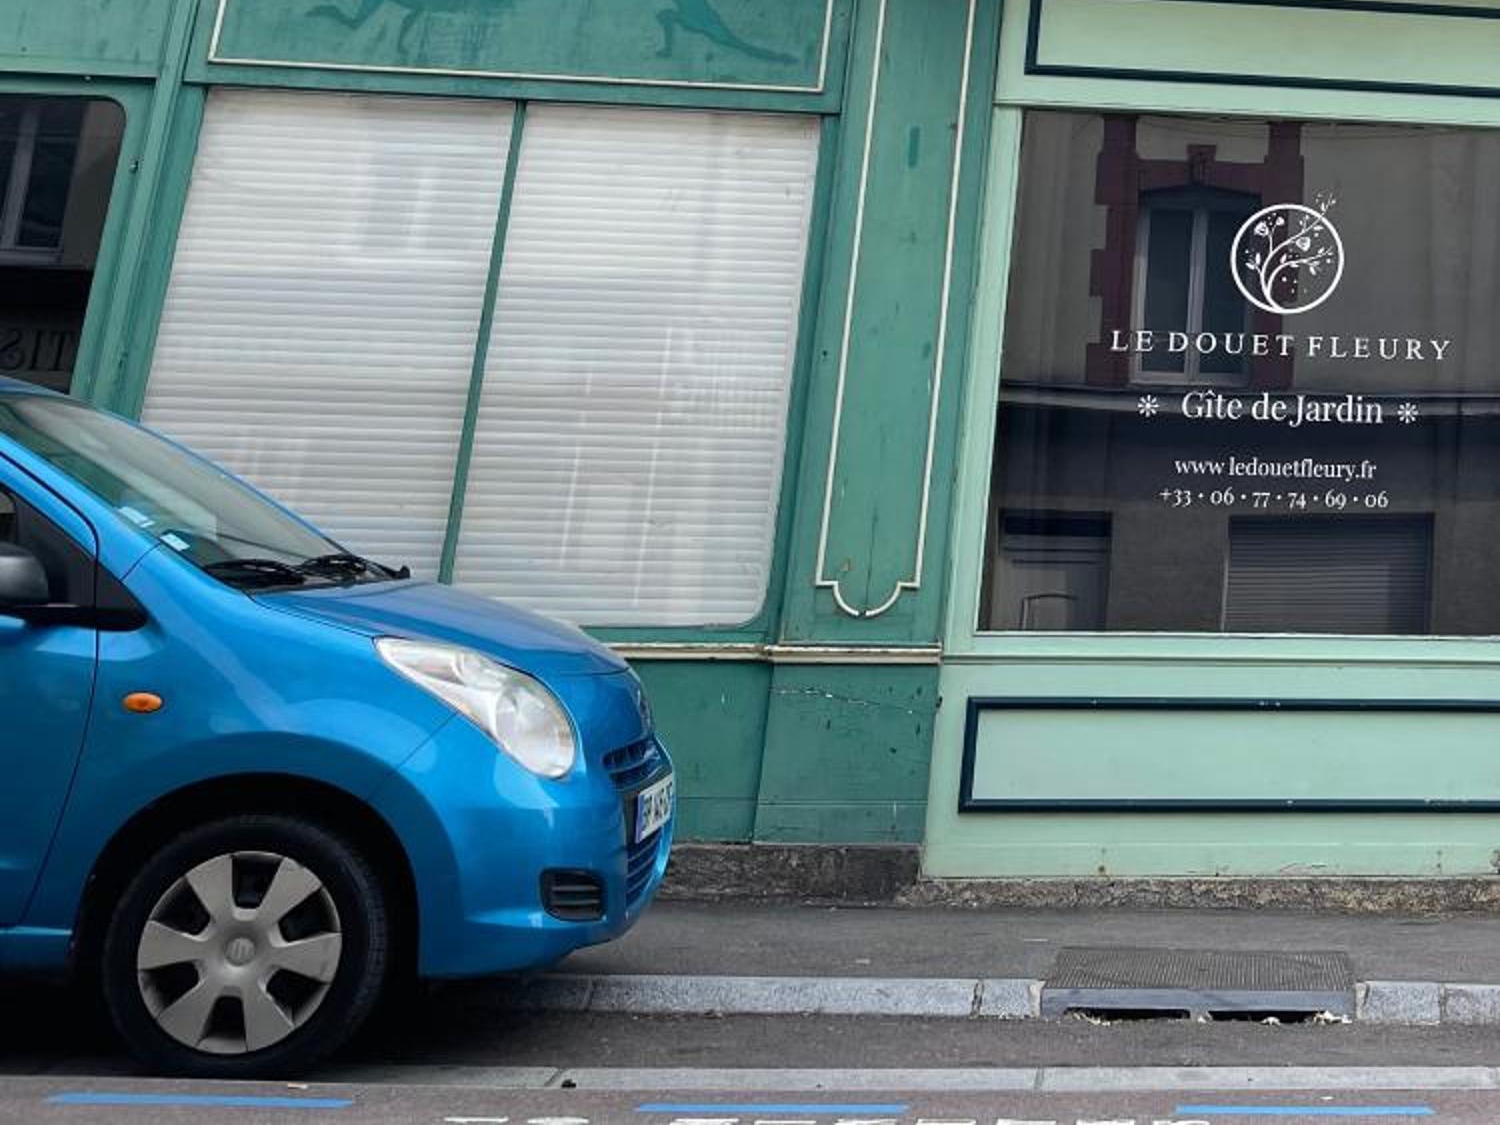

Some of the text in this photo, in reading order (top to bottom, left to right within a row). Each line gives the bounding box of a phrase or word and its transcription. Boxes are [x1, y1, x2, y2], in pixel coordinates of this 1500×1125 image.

[1110, 329, 1451, 360] LE DOUET FLEURY
[1181, 389, 1384, 427] Gîte de Jardin
